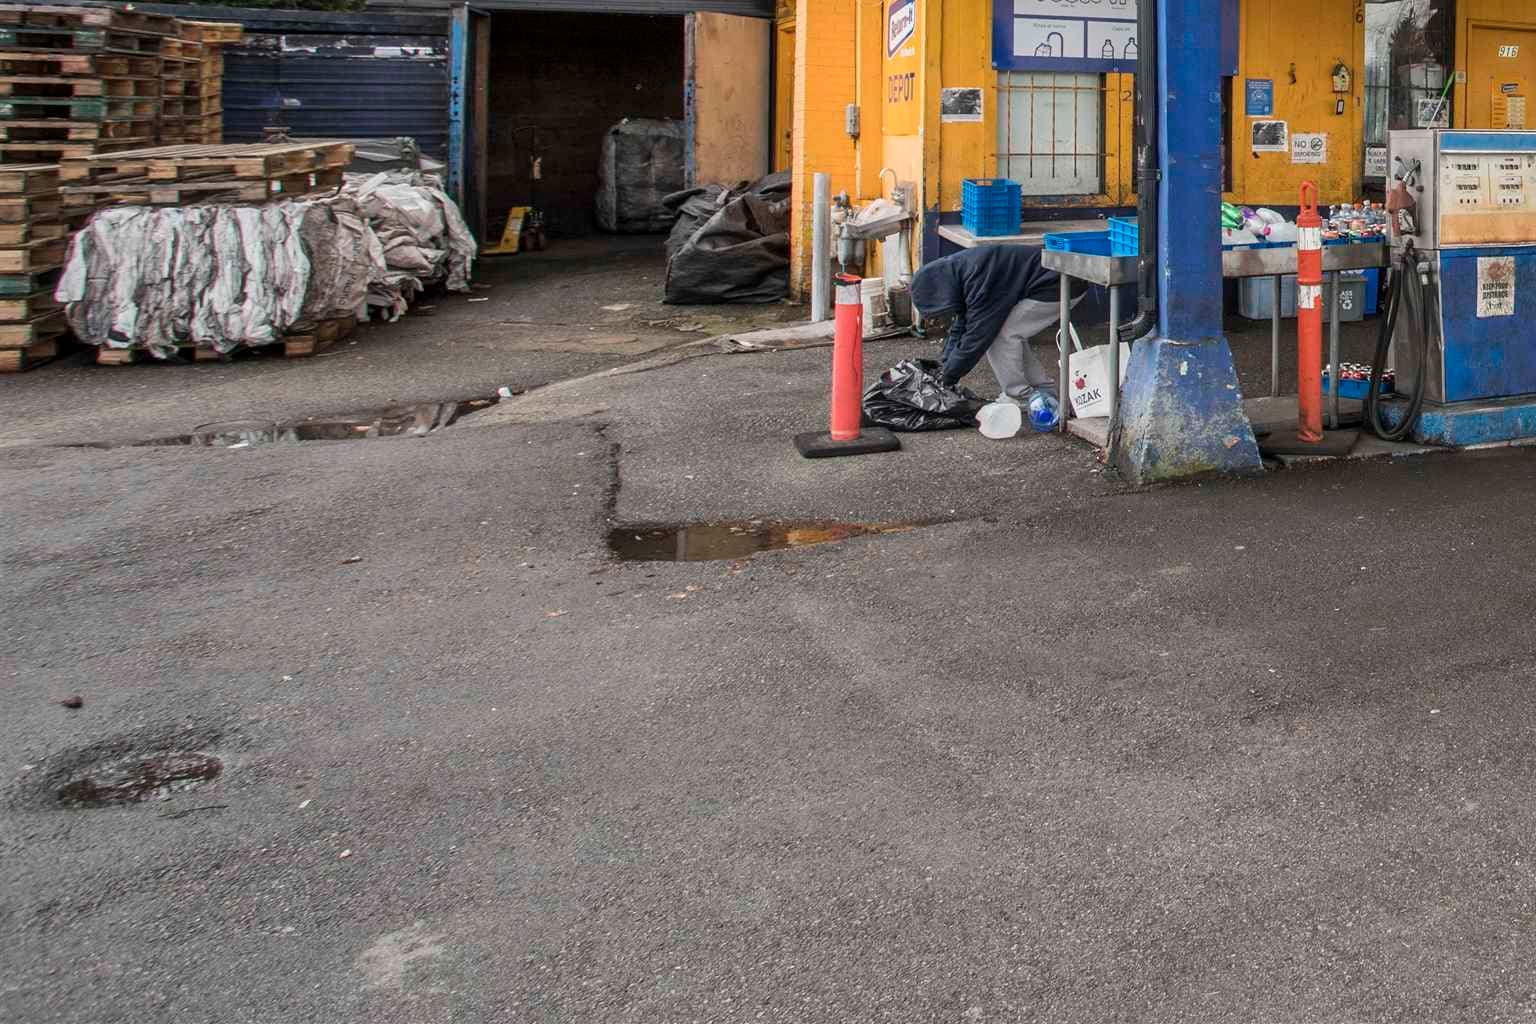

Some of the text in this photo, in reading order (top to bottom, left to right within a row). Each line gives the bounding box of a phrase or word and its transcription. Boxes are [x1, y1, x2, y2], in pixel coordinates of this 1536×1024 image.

[1500, 46, 1519, 56] 916
[888, 72, 915, 103] DEPOT
[1294, 140, 1307, 149] NO
